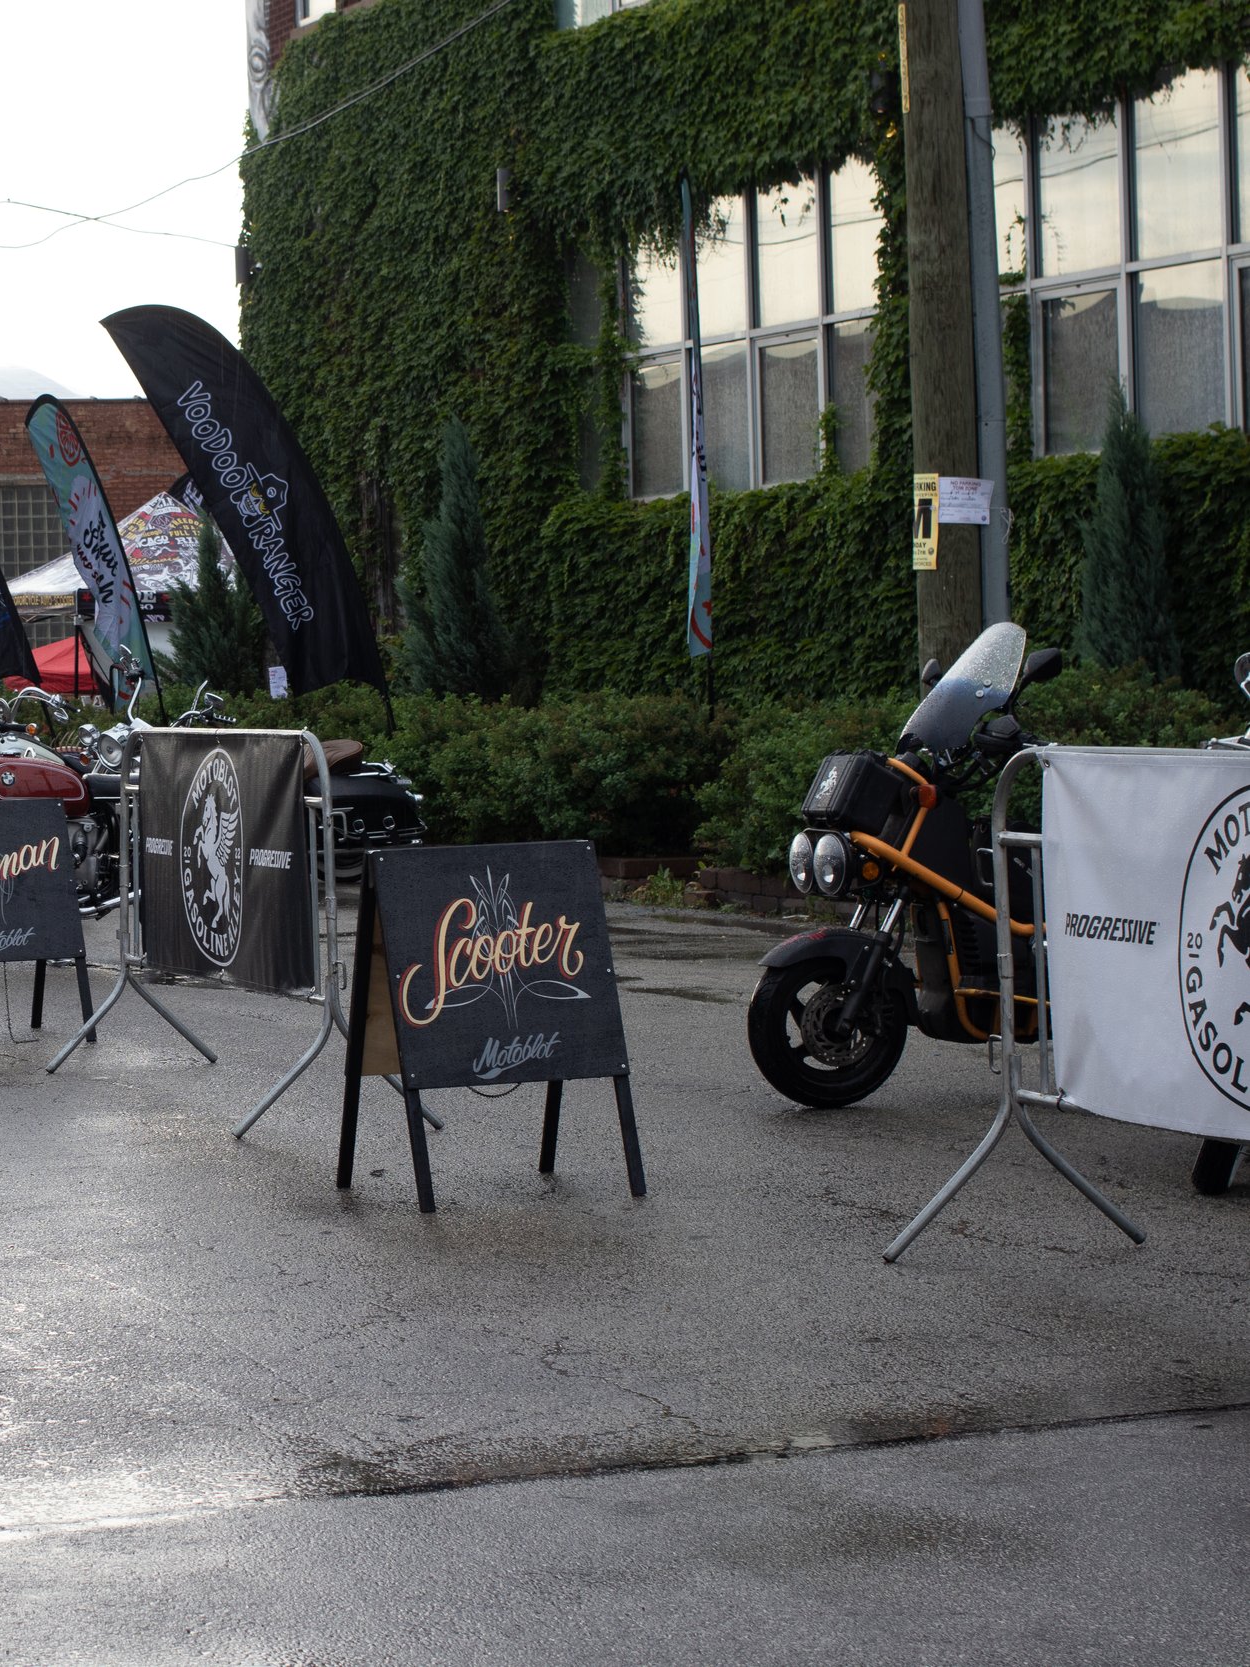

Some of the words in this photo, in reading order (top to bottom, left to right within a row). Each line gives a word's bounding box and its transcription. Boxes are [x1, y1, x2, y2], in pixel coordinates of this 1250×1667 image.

[177, 380, 247, 488] VOODOO
[249, 515, 314, 631] RANGER
[191, 758, 238, 810] MOTOBLOT
[146, 837, 174, 857] PROGRESSIVE
[183, 846, 192, 857] 20
[249, 848, 293, 870] PROGRESSIVE
[184, 866, 229, 957] GASOLINE
[1065, 912, 1157, 945] PROGRESSIVE
[399, 898, 584, 1029] Scooter
[1187, 932, 1202, 950] 20
[472, 1031, 562, 1080] Motoblot
